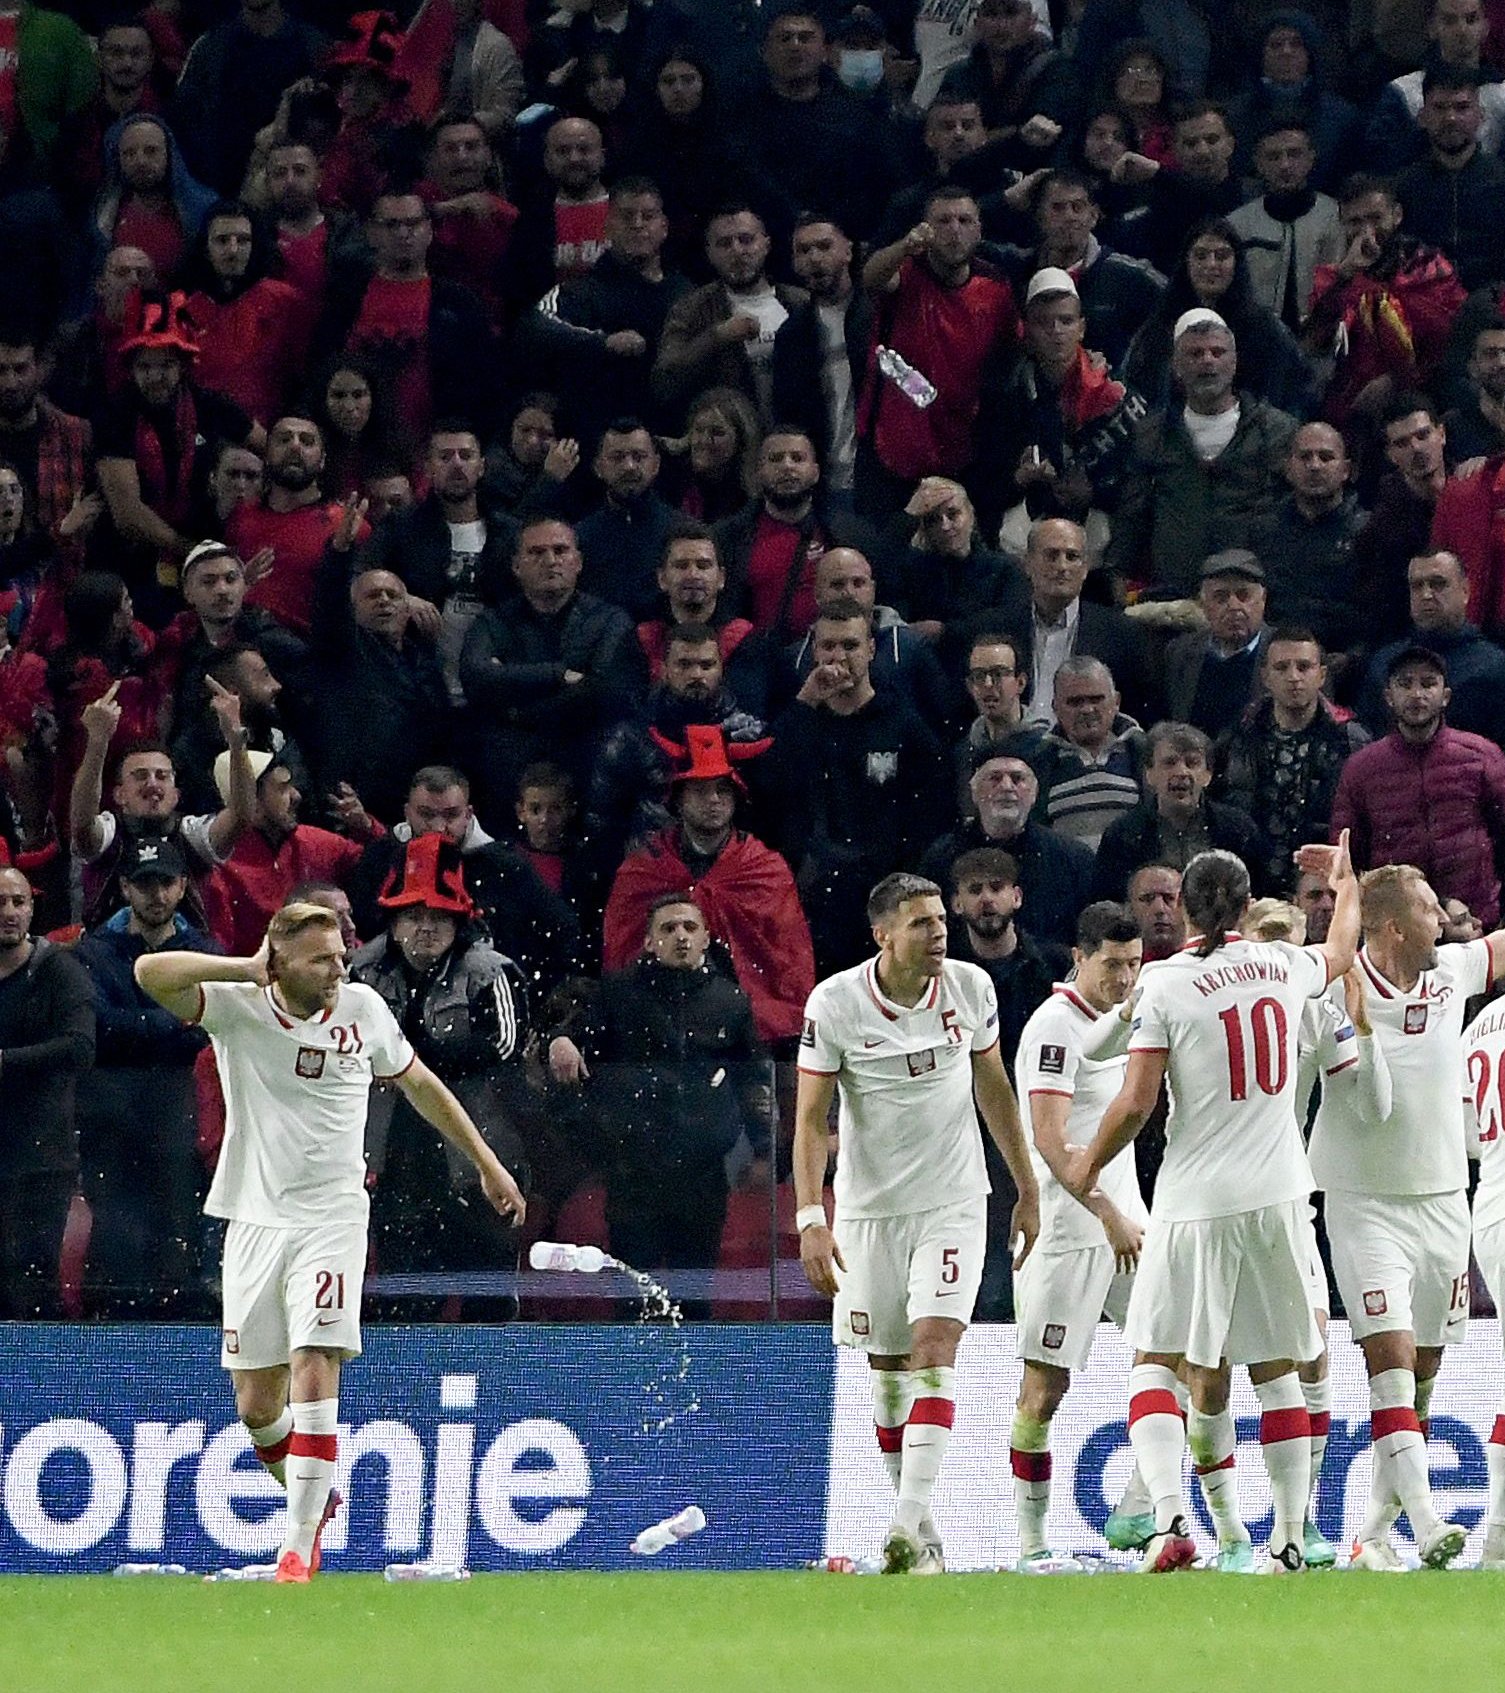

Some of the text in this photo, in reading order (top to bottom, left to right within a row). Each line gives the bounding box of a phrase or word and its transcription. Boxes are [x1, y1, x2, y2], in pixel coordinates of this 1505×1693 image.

[329, 1021, 364, 1054] 21
[1218, 996, 1288, 1101] 10
[941, 1248, 960, 1284] 5
[315, 1269, 344, 1309] 21
[1449, 1272, 1469, 1310] 15
[0, 1373, 593, 1567] orenje
